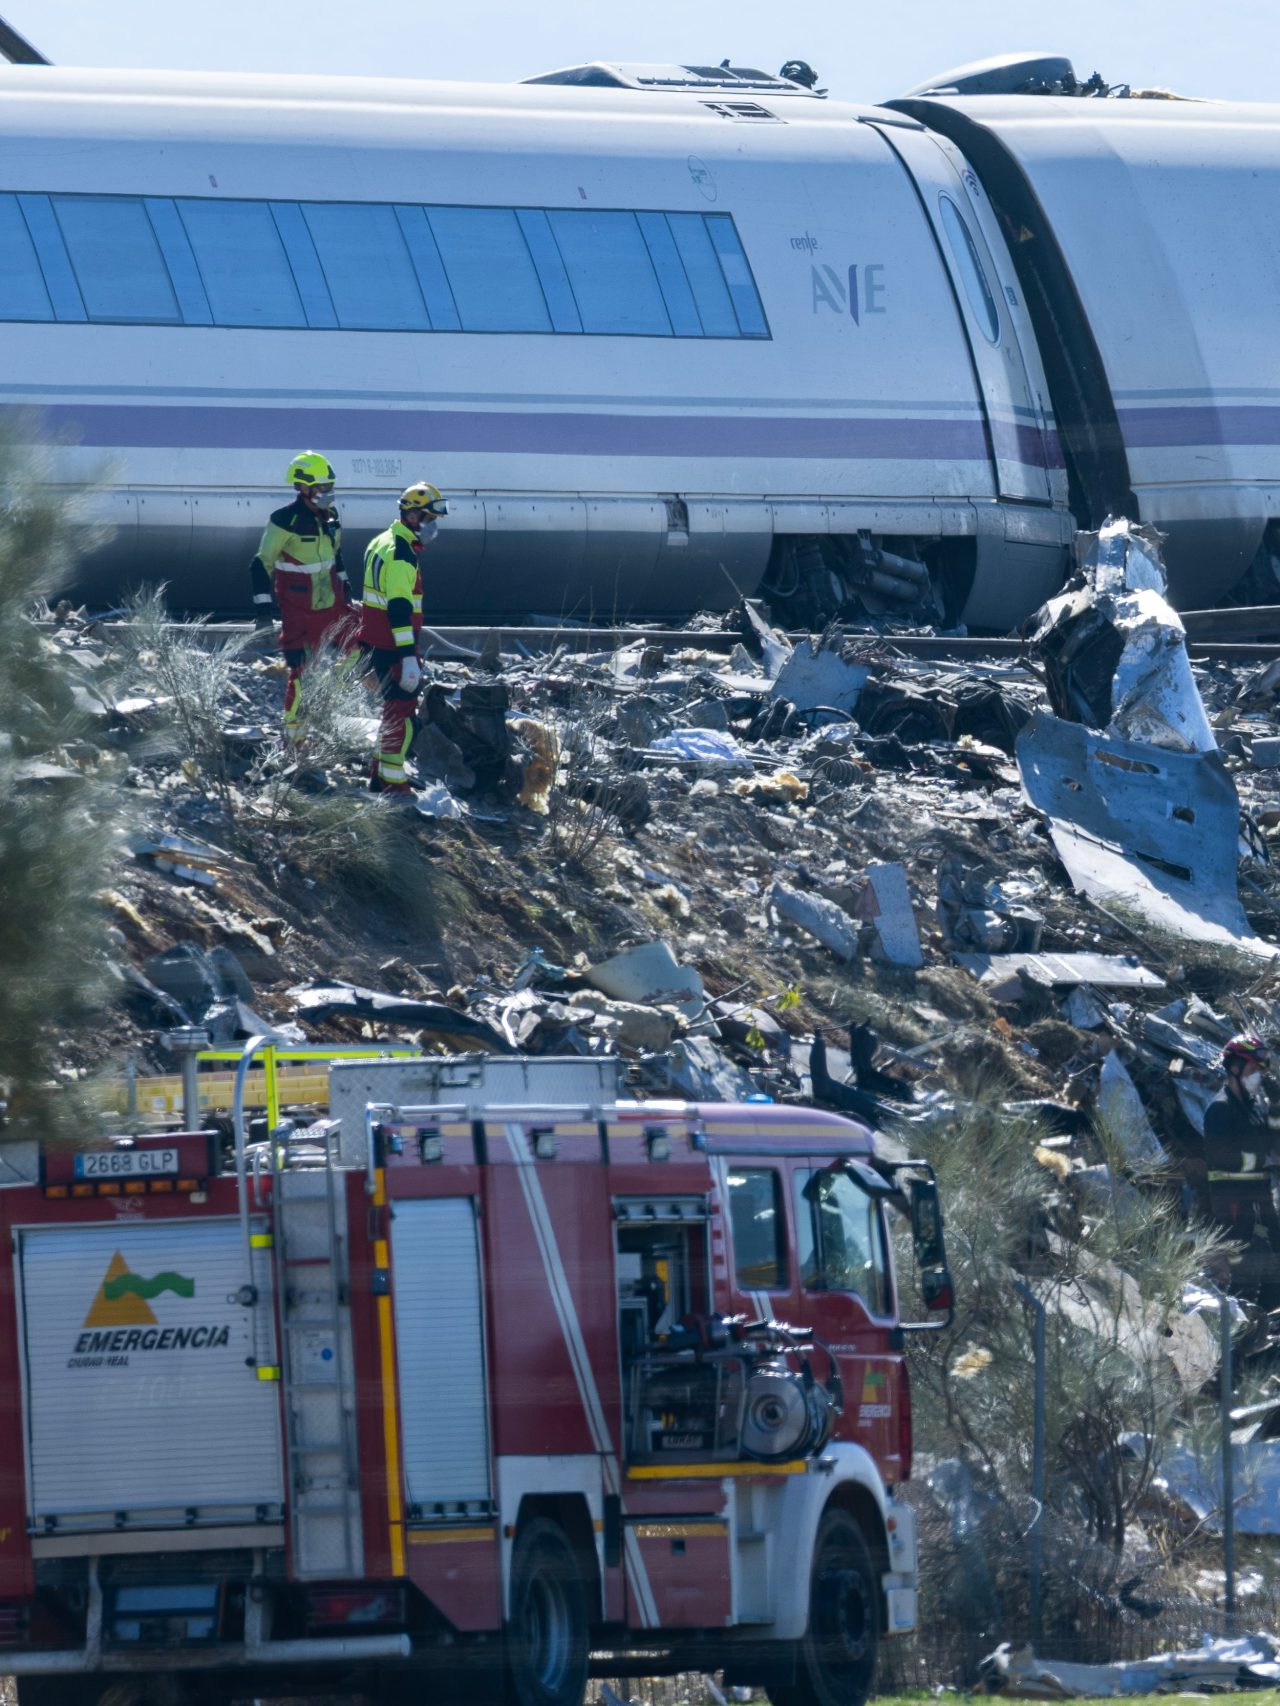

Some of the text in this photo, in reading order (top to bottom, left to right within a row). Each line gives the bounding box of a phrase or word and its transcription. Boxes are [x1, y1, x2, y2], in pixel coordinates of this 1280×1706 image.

[790, 231, 819, 256] renfe
[811, 264, 887, 328] AVE
[86, 1151, 173, 1174] 2668 GLP
[74, 1324, 230, 1353] EMERGENCIA
